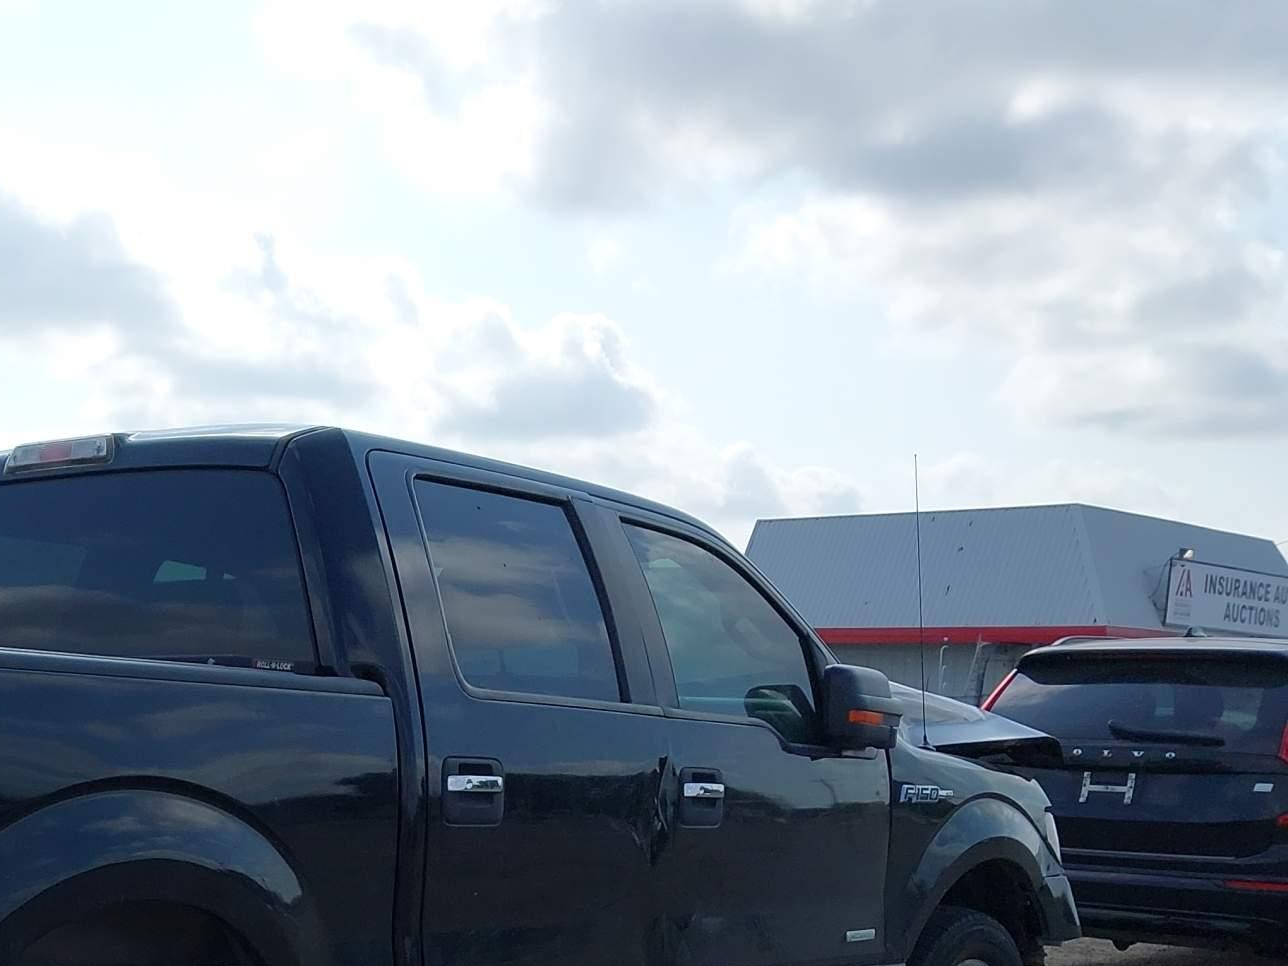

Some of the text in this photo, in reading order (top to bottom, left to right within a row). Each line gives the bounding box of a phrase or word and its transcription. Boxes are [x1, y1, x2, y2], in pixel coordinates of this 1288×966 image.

[1203, 573, 1288, 605] INSURANCE AU
[1223, 602, 1281, 628] AUCTIONS
